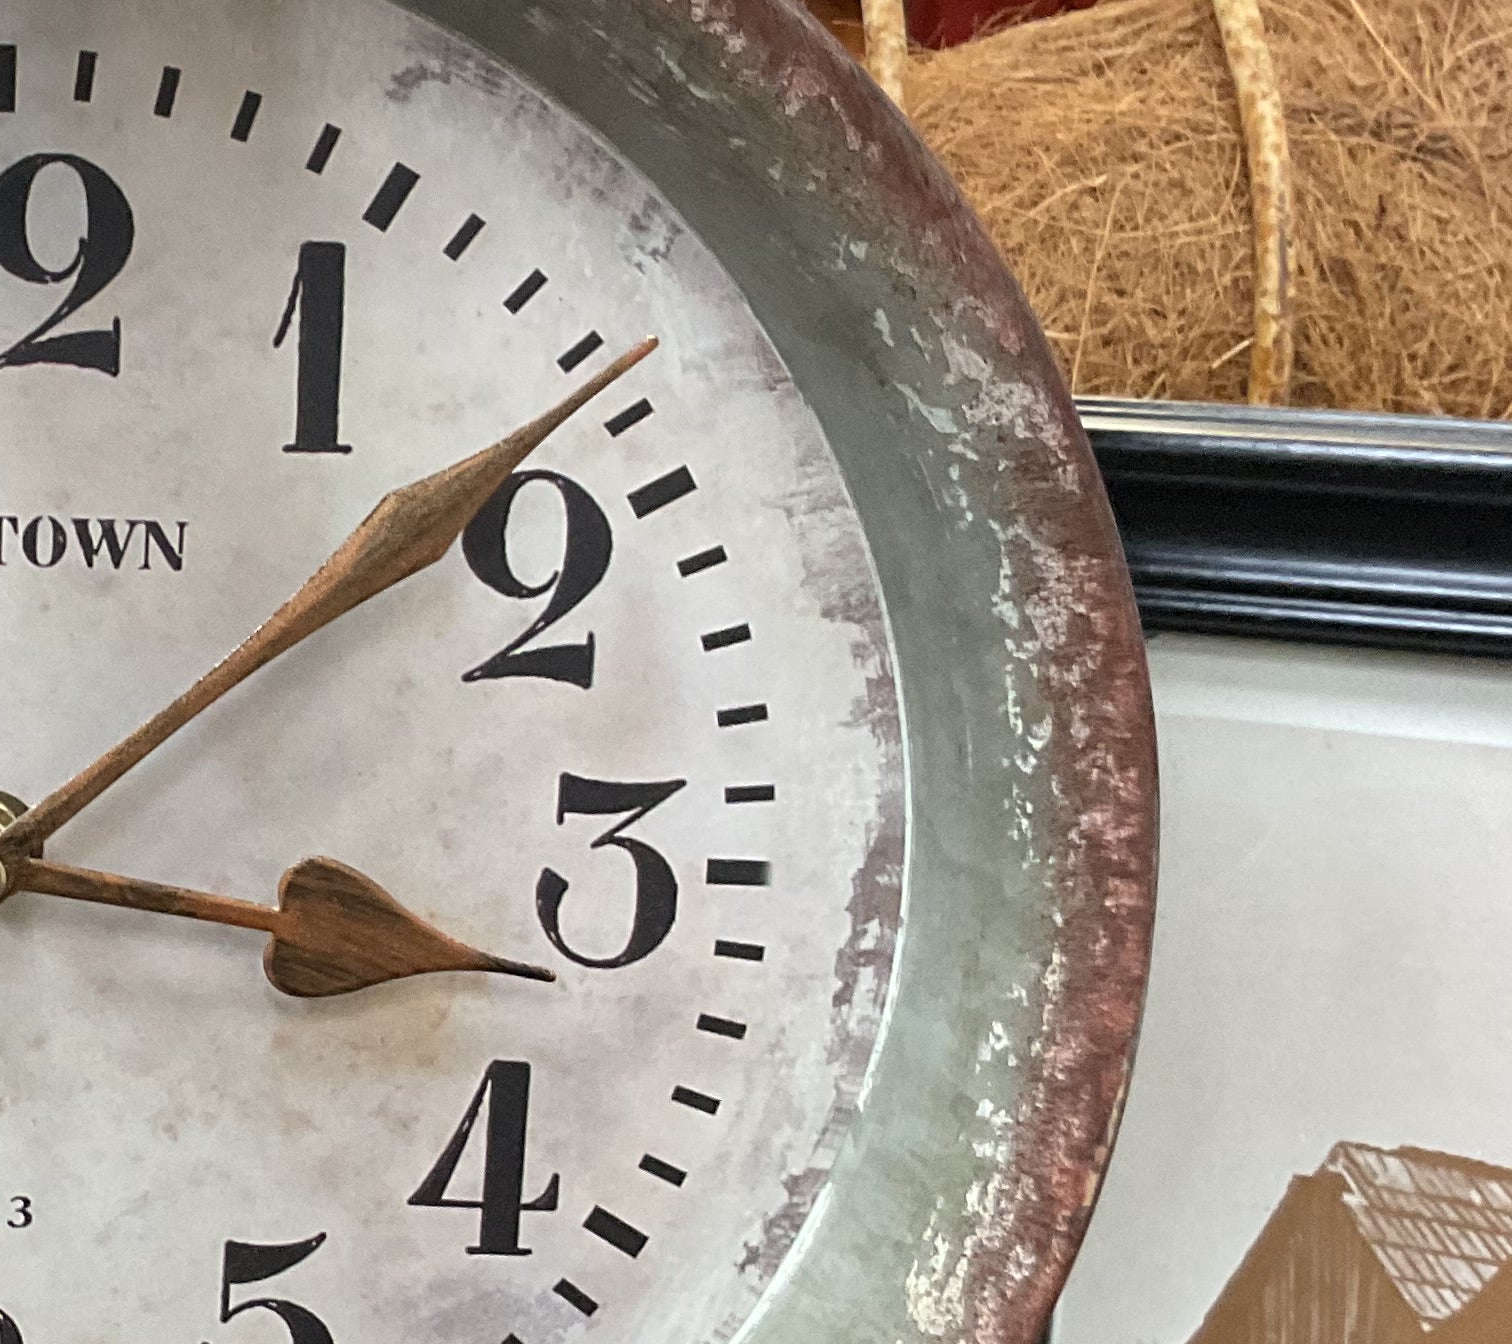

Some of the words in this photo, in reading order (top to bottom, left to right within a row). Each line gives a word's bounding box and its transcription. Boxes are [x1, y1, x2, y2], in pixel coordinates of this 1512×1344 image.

[273, 241, 353, 454] 1
[461, 469, 613, 689] 2
[535, 772, 687, 969] 3
[407, 1060, 560, 1257] 4
